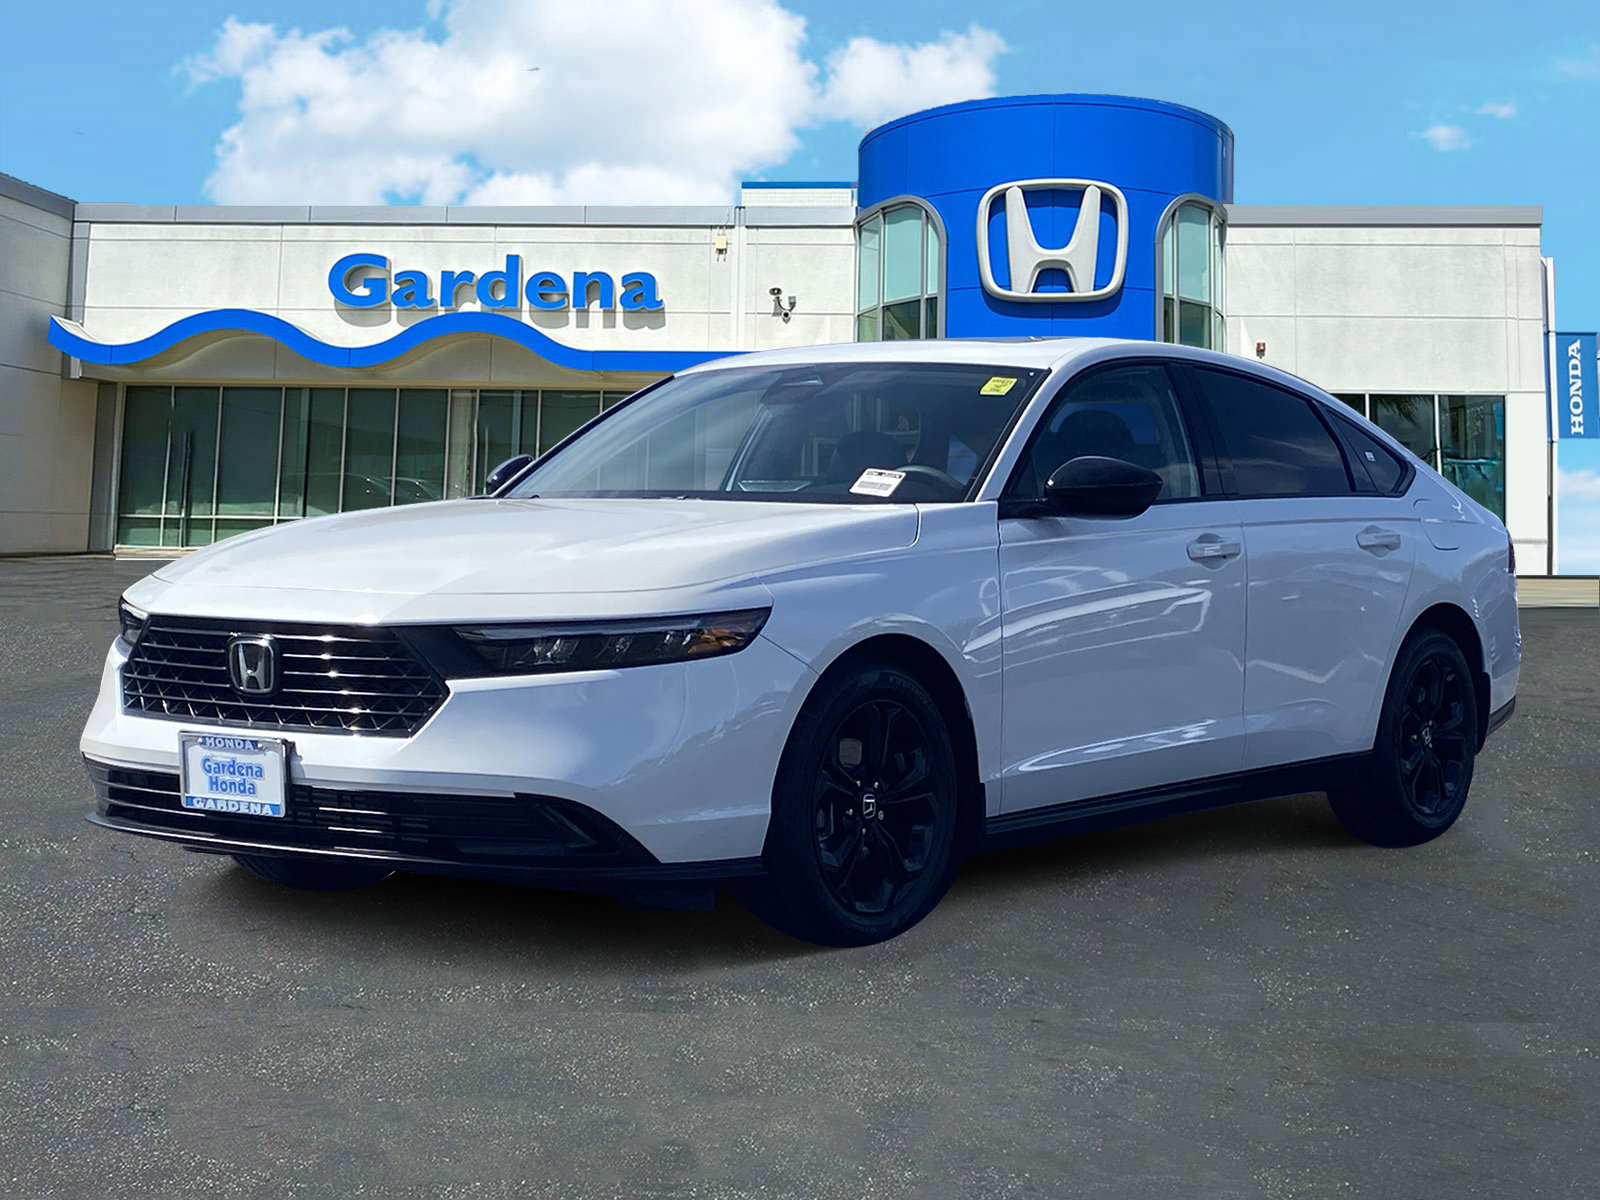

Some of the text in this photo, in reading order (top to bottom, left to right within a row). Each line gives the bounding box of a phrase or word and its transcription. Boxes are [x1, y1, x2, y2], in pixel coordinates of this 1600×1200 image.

[328, 252, 664, 309] Gardena
[1568, 339, 1584, 435] HONDA
[205, 737, 255, 751] HONDA
[201, 756, 264, 778] Gardena
[208, 775, 257, 795] Honda
[192, 797, 274, 816] GARDENA
